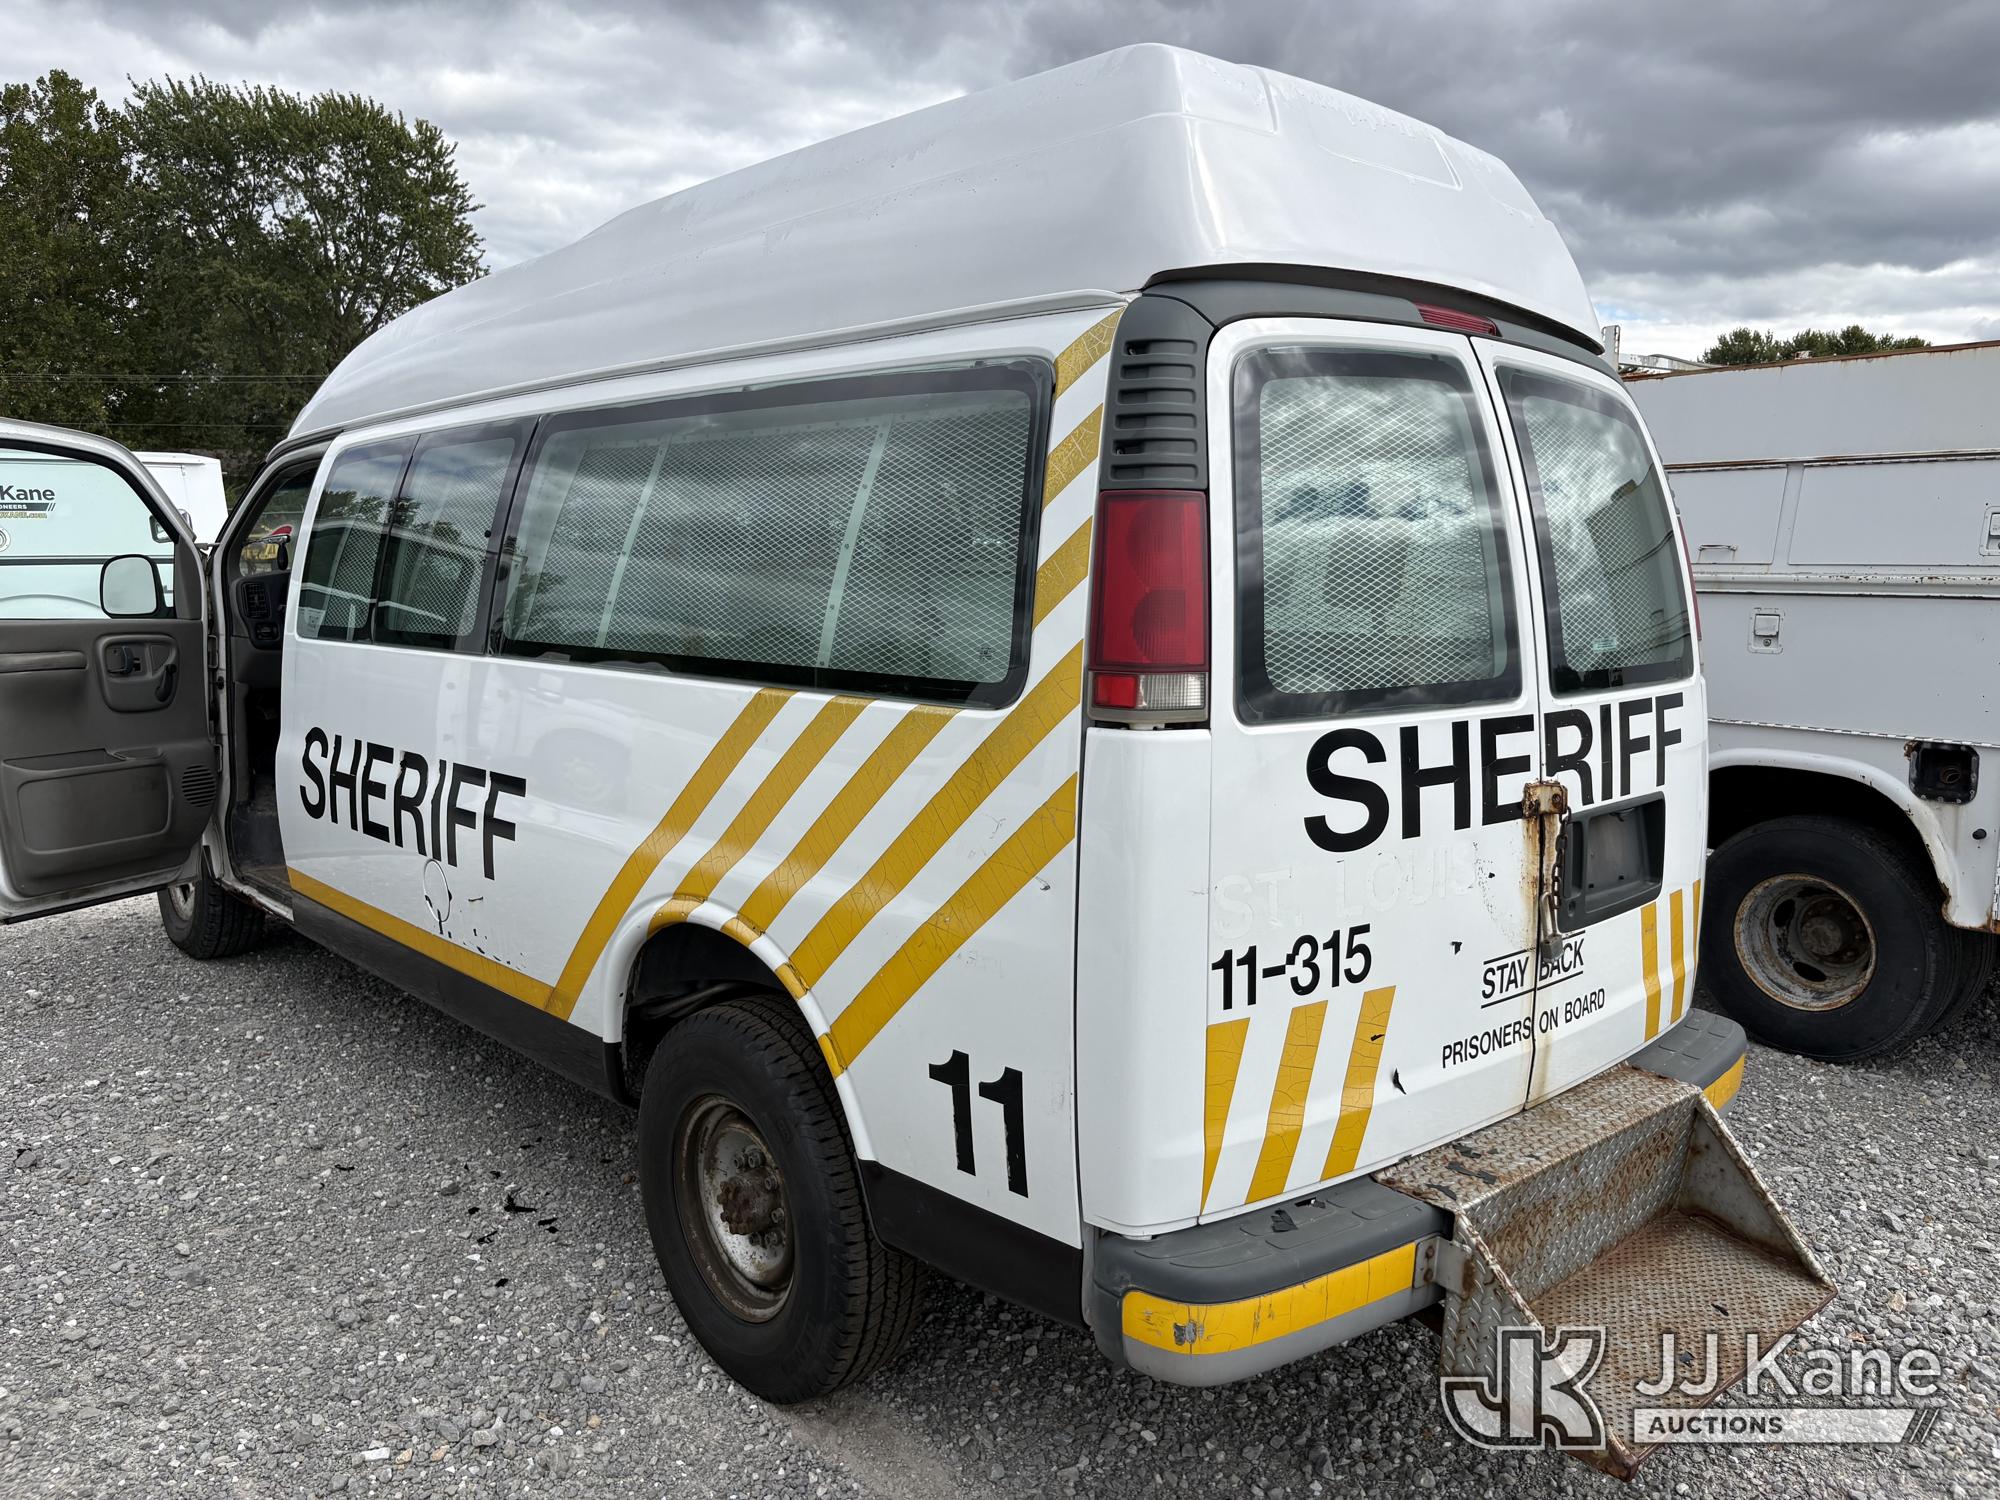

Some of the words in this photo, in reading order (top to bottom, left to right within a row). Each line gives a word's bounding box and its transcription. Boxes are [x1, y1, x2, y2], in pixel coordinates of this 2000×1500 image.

[0, 485, 56, 501] Kane
[299, 726, 527, 881] SHERIFF
[1303, 692, 1685, 853] SHERIFF
[1211, 924, 1372, 1011] 11-315
[1481, 956, 1530, 999] STAY
[1441, 1016, 1532, 1069] PRISONERS
[1539, 1007, 1559, 1034] ON
[1564, 988, 1606, 1024] BOARD
[928, 1049, 1029, 1199] 11
